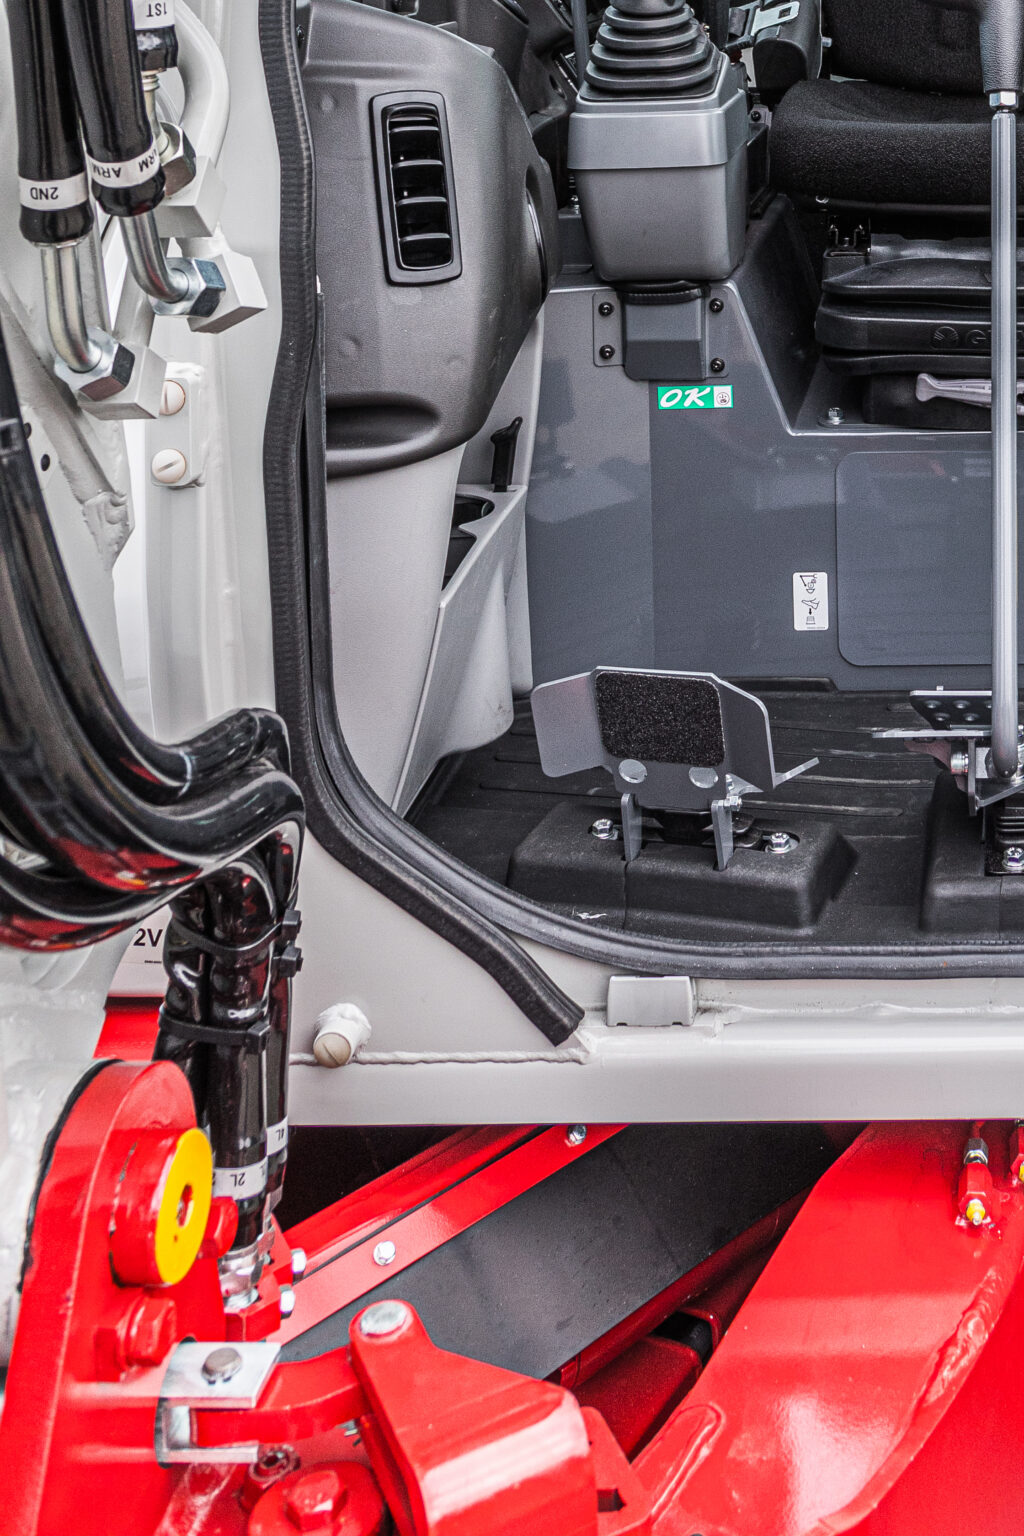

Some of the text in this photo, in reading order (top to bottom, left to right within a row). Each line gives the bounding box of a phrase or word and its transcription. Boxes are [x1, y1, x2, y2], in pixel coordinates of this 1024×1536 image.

[145, 1, 168, 18] 1ST
[29, 186, 59, 200] 2ND
[660, 386, 711, 408] OK
[229, 1172, 246, 1187] 2L
